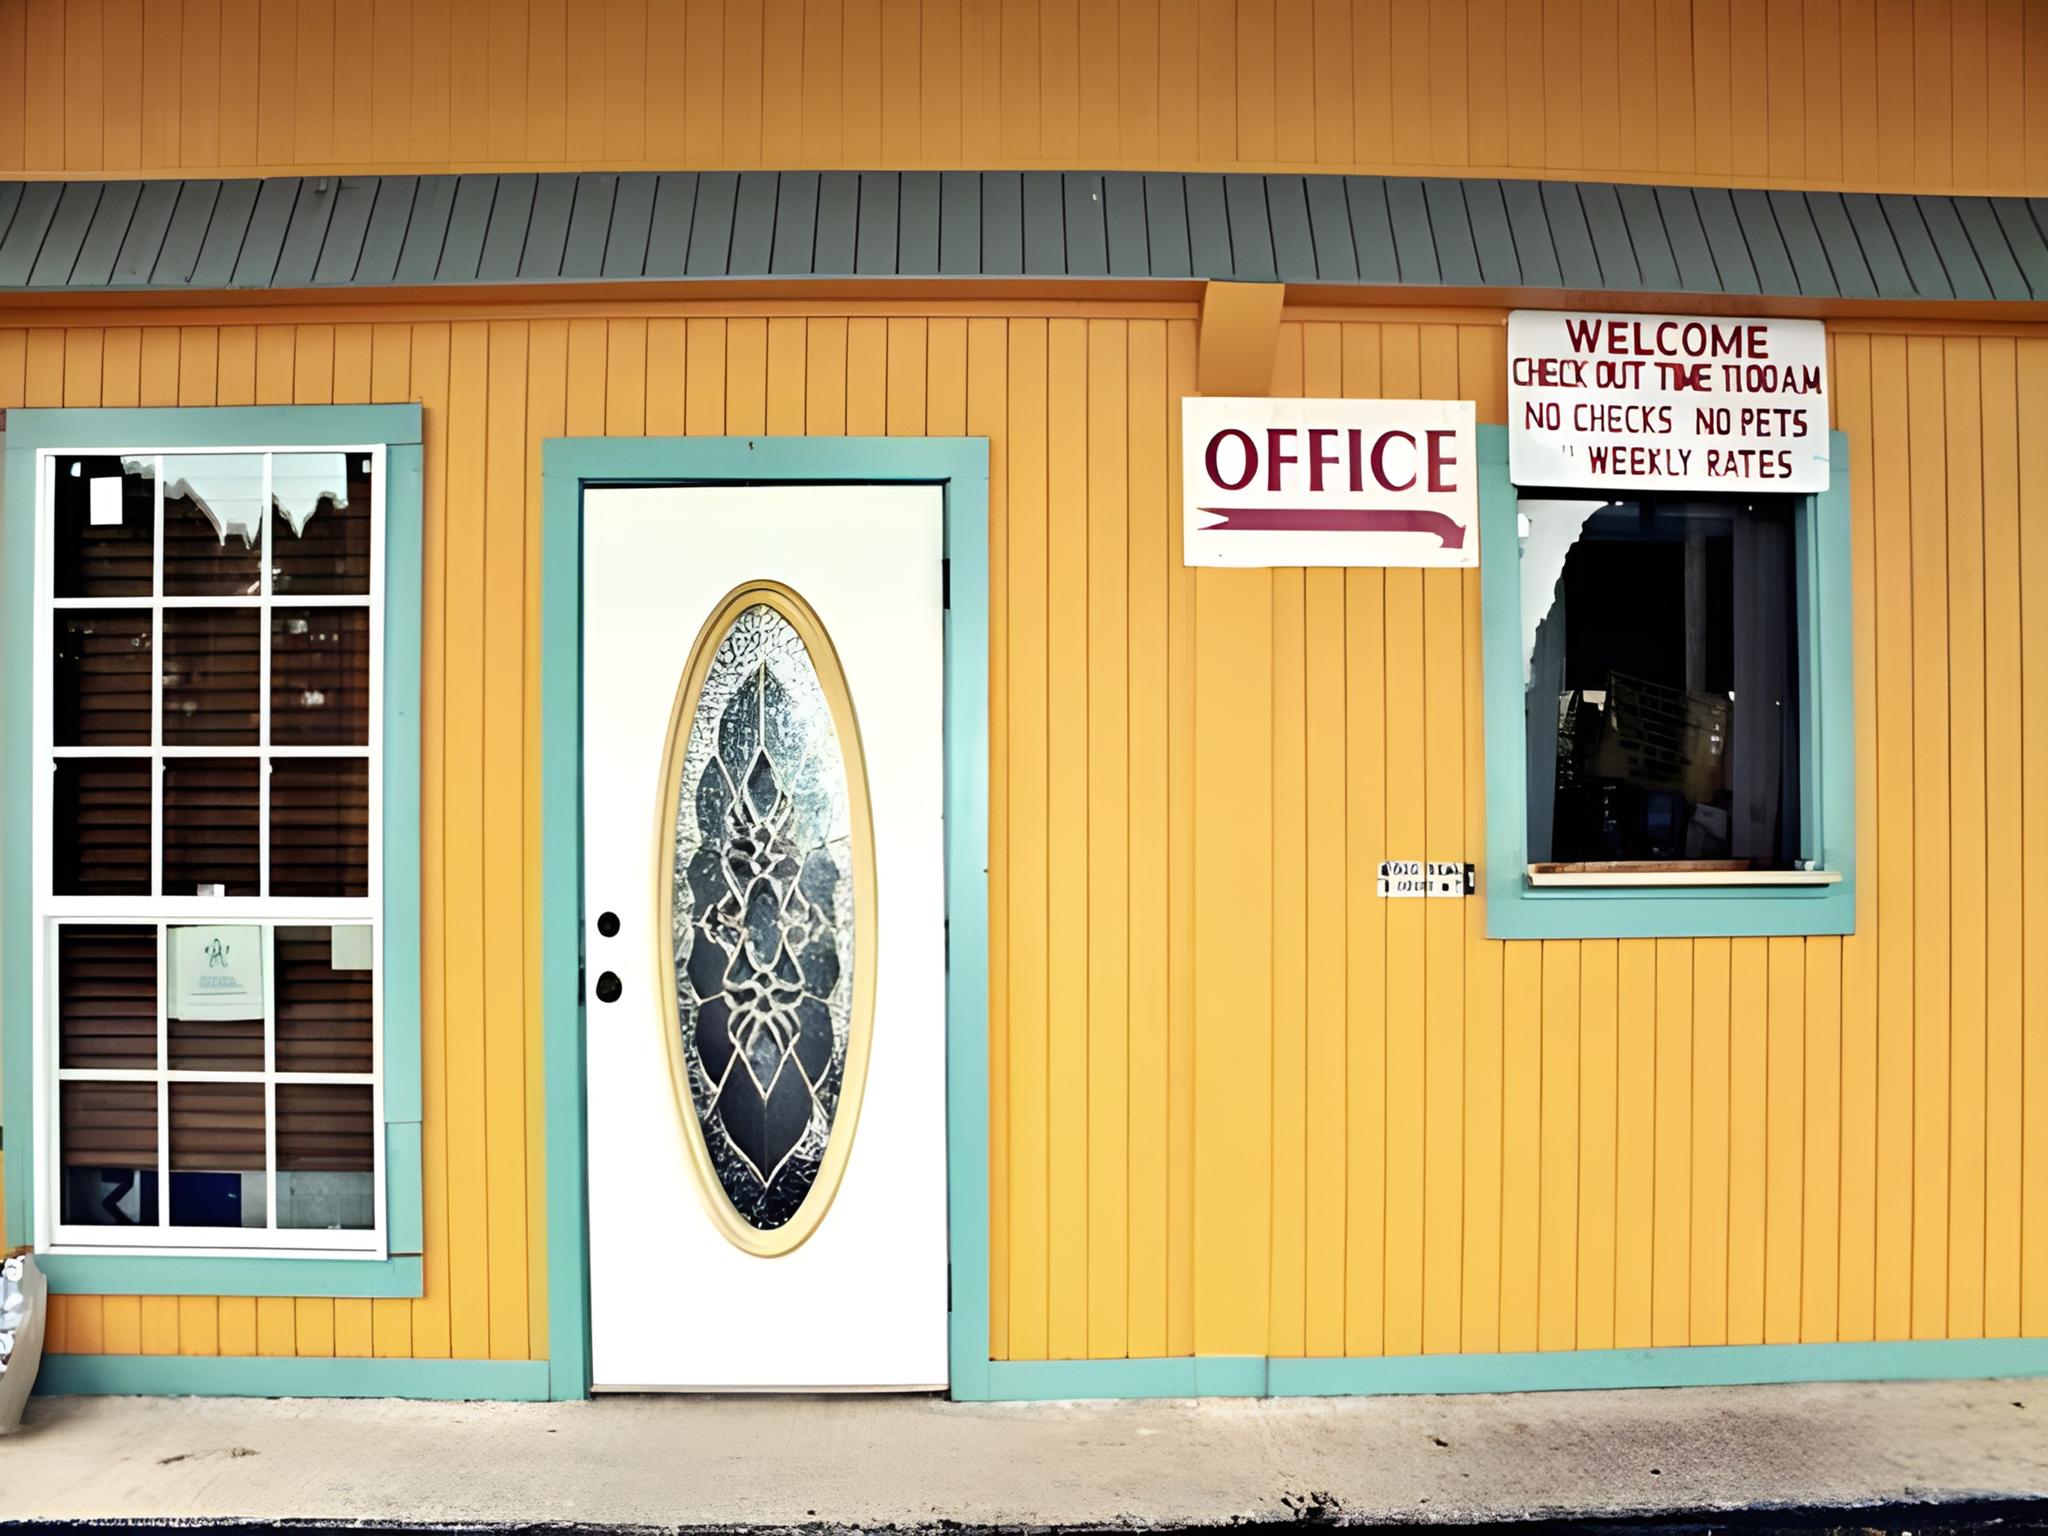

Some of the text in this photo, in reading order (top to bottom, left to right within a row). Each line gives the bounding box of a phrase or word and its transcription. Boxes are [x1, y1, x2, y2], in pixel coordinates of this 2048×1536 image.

[1566, 319, 1769, 359] WELCOME
[1513, 358, 1588, 388] CHECK
[1596, 361, 1645, 390] OUT
[1525, 401, 1808, 438] NO CHECKS NO PETS
[1205, 428, 1457, 493] OFFICE
[1588, 446, 1793, 479] WEEKLY RATES
